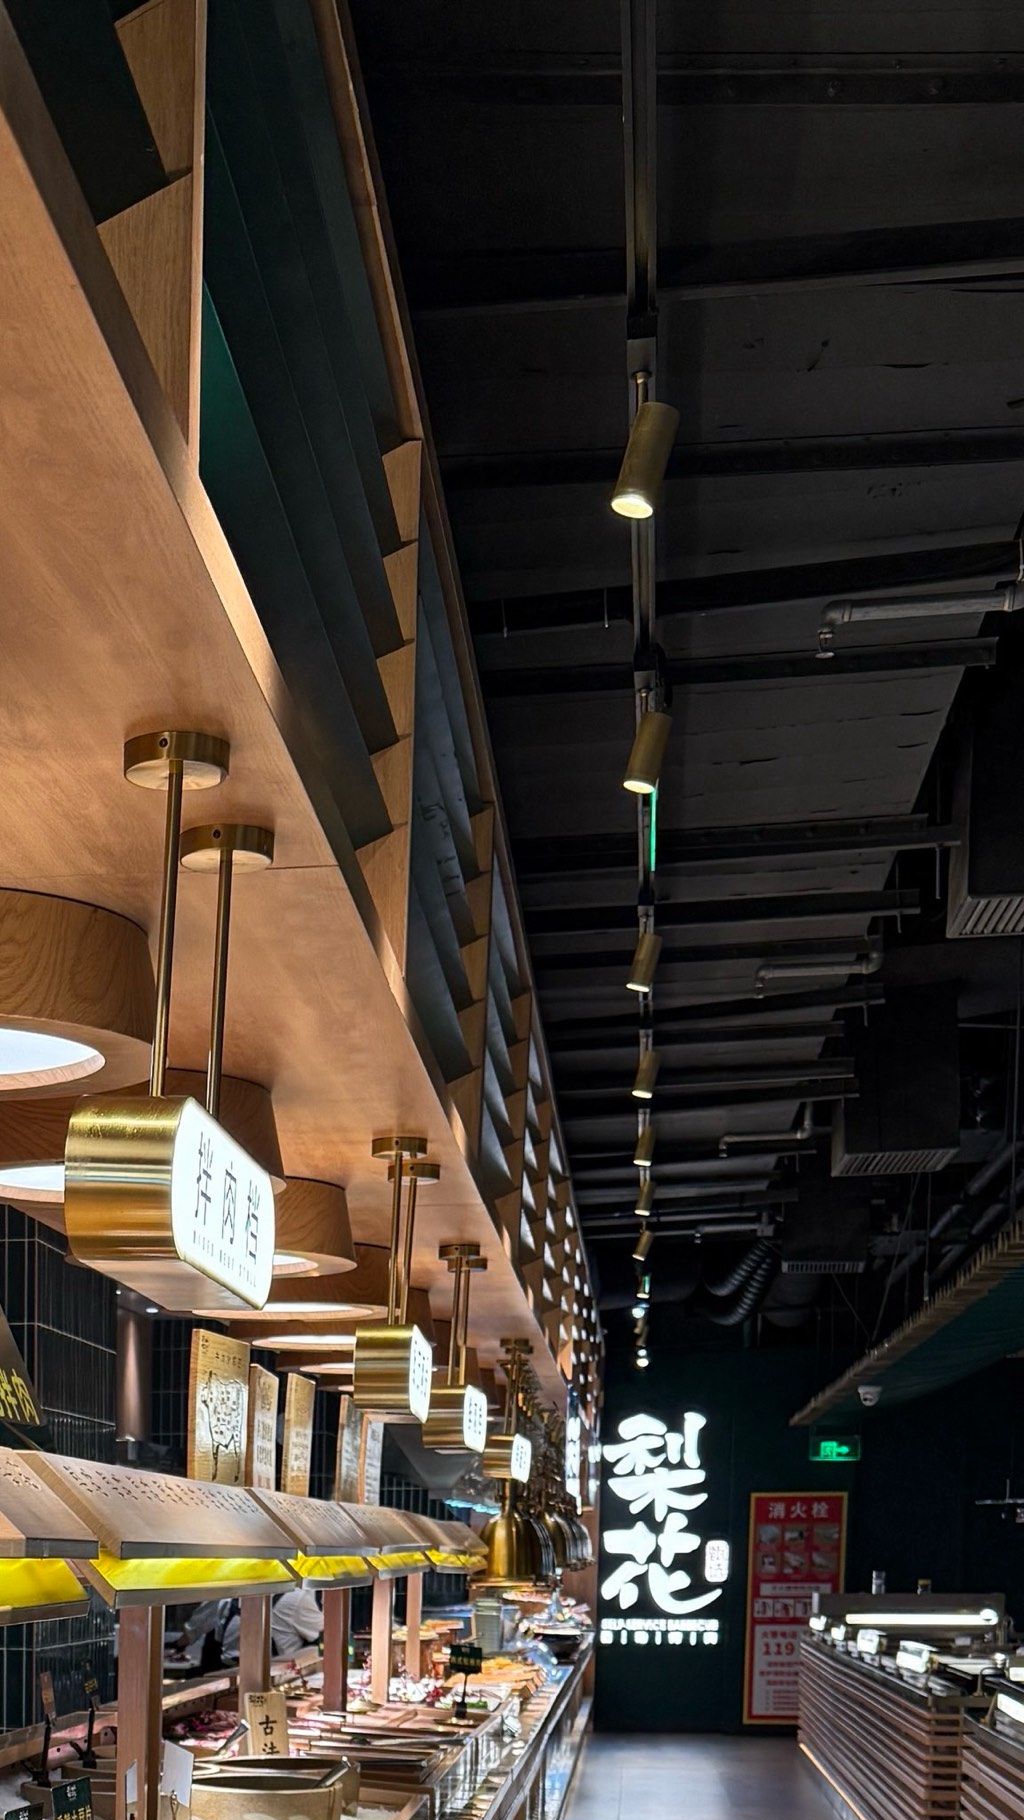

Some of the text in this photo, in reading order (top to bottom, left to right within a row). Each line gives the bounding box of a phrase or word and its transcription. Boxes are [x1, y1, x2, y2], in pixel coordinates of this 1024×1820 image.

[601, 1411, 724, 1615] 梨花
[768, 1501, 829, 1519] 消火栓
[762, 1641, 796, 1657] 119
